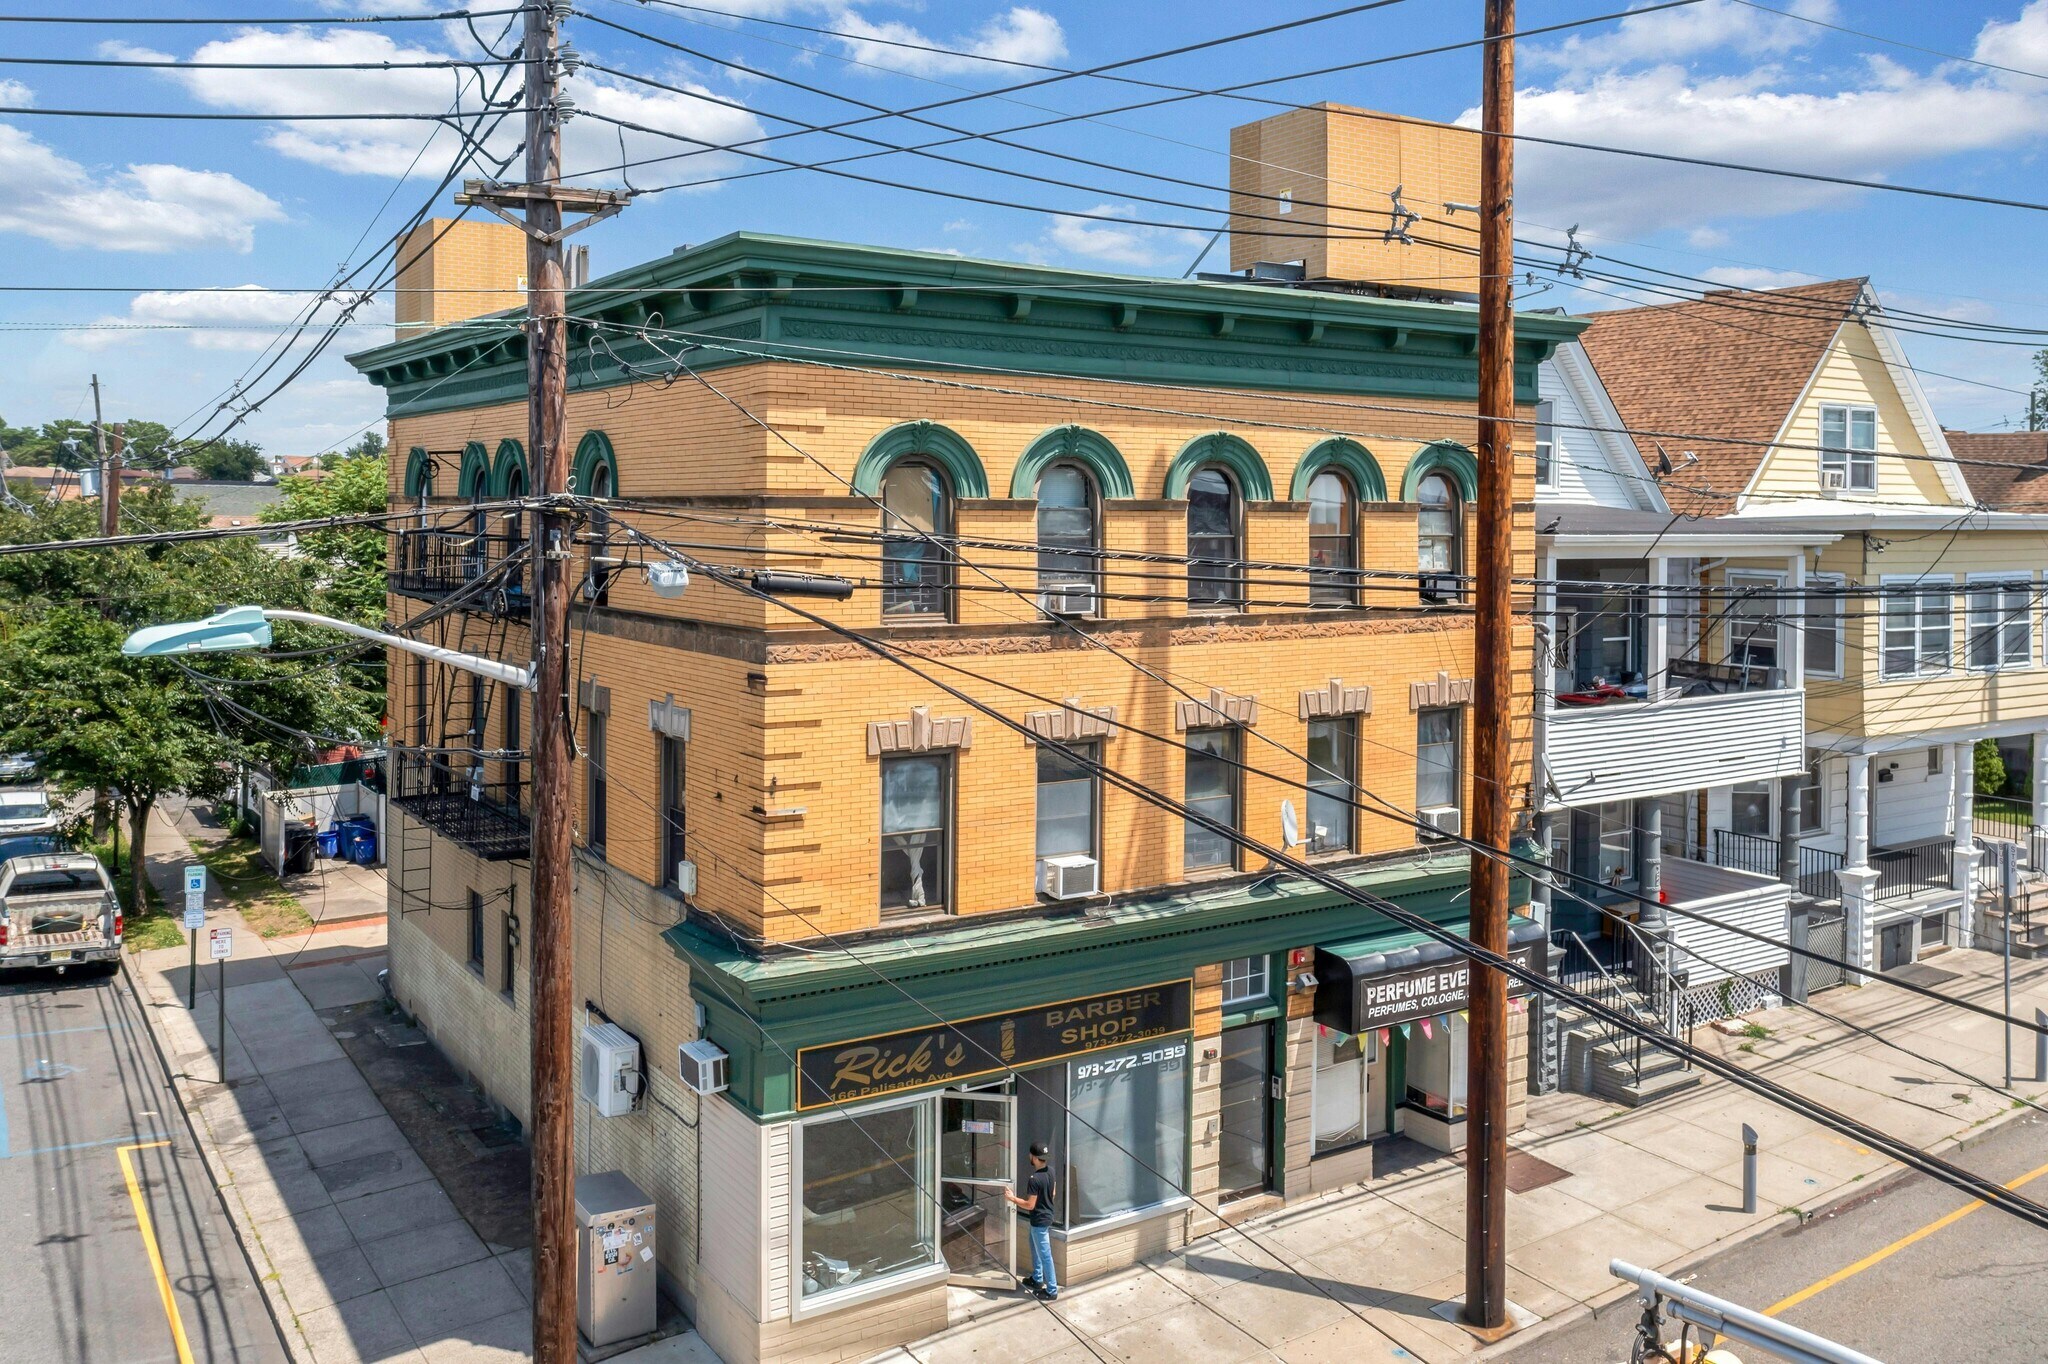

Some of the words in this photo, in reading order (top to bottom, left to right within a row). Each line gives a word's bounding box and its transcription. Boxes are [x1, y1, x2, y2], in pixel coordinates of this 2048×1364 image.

[1367, 974, 1436, 1005] PERFUME
[1368, 1000, 1418, 1018] PERFUMES,
[1422, 990, 1466, 1007] COLOGNE,
[1046, 992, 1161, 1027] BARBER
[1061, 1017, 1137, 1044] SHOP
[1085, 1027, 1166, 1049] 973-272-3039
[830, 1034, 965, 1089] Rick's
[830, 1090, 857, 1101] 166
[861, 1077, 922, 1096] Palisade
[927, 1071, 953, 1083] Ave
